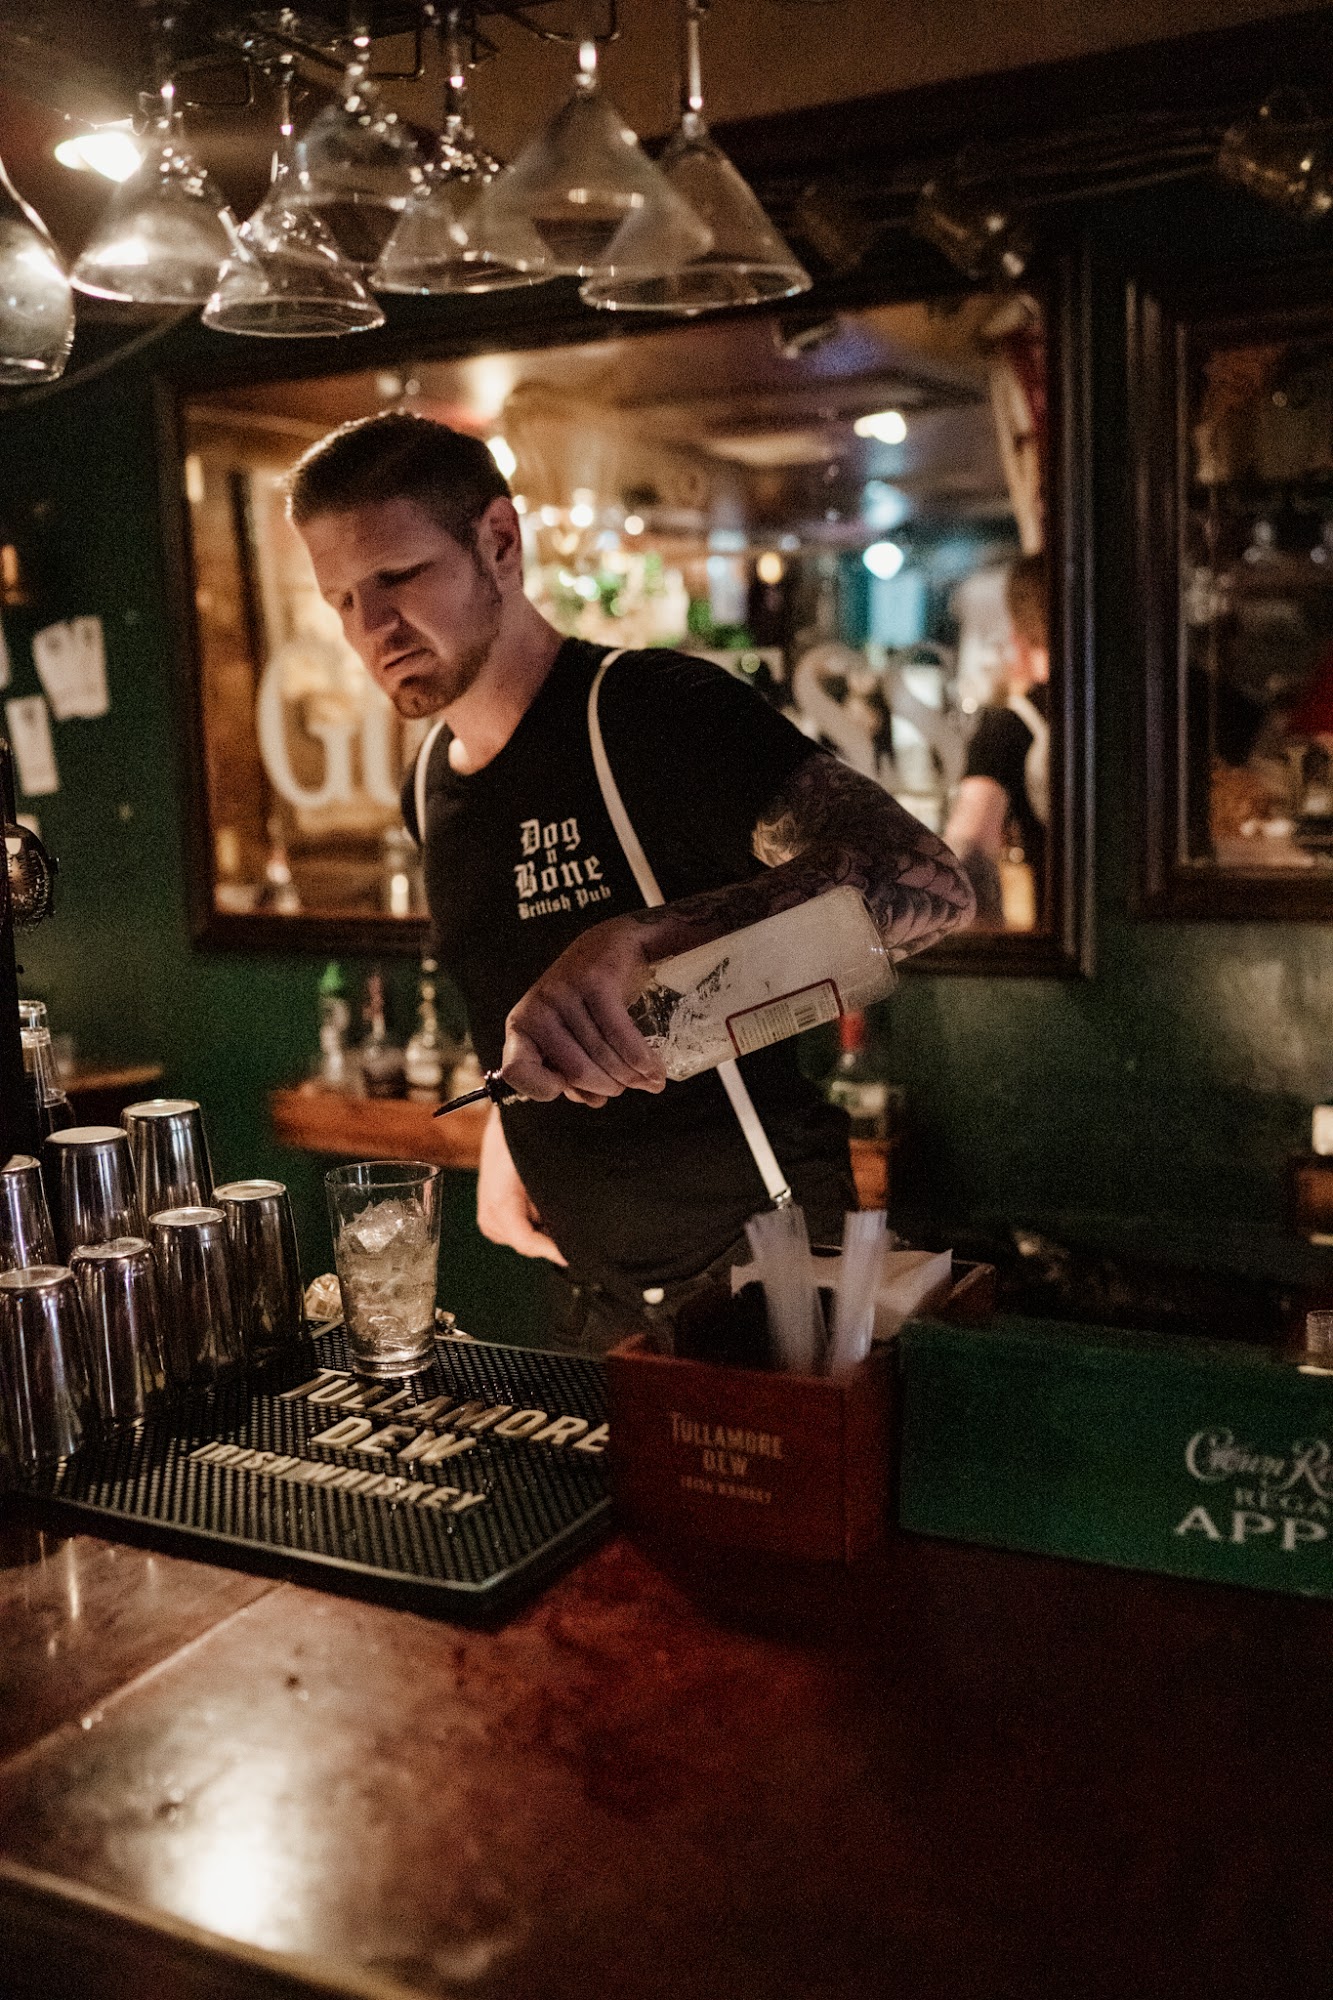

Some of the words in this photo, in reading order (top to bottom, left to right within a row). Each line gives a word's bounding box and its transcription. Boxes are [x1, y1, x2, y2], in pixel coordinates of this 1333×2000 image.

[519, 817, 581, 857] Dog
[546, 848, 558, 864] n
[513, 855, 604, 900] Bone
[517, 893, 572, 920] British
[575, 885, 611, 909] Pub
[279, 1368, 611, 1454] TULLAMORE
[310, 1416, 478, 1467] DEW
[188, 1441, 301, 1476] IRISH
[302, 1461, 486, 1513] WHISKEY
[1173, 1504, 1328, 1551] APP
